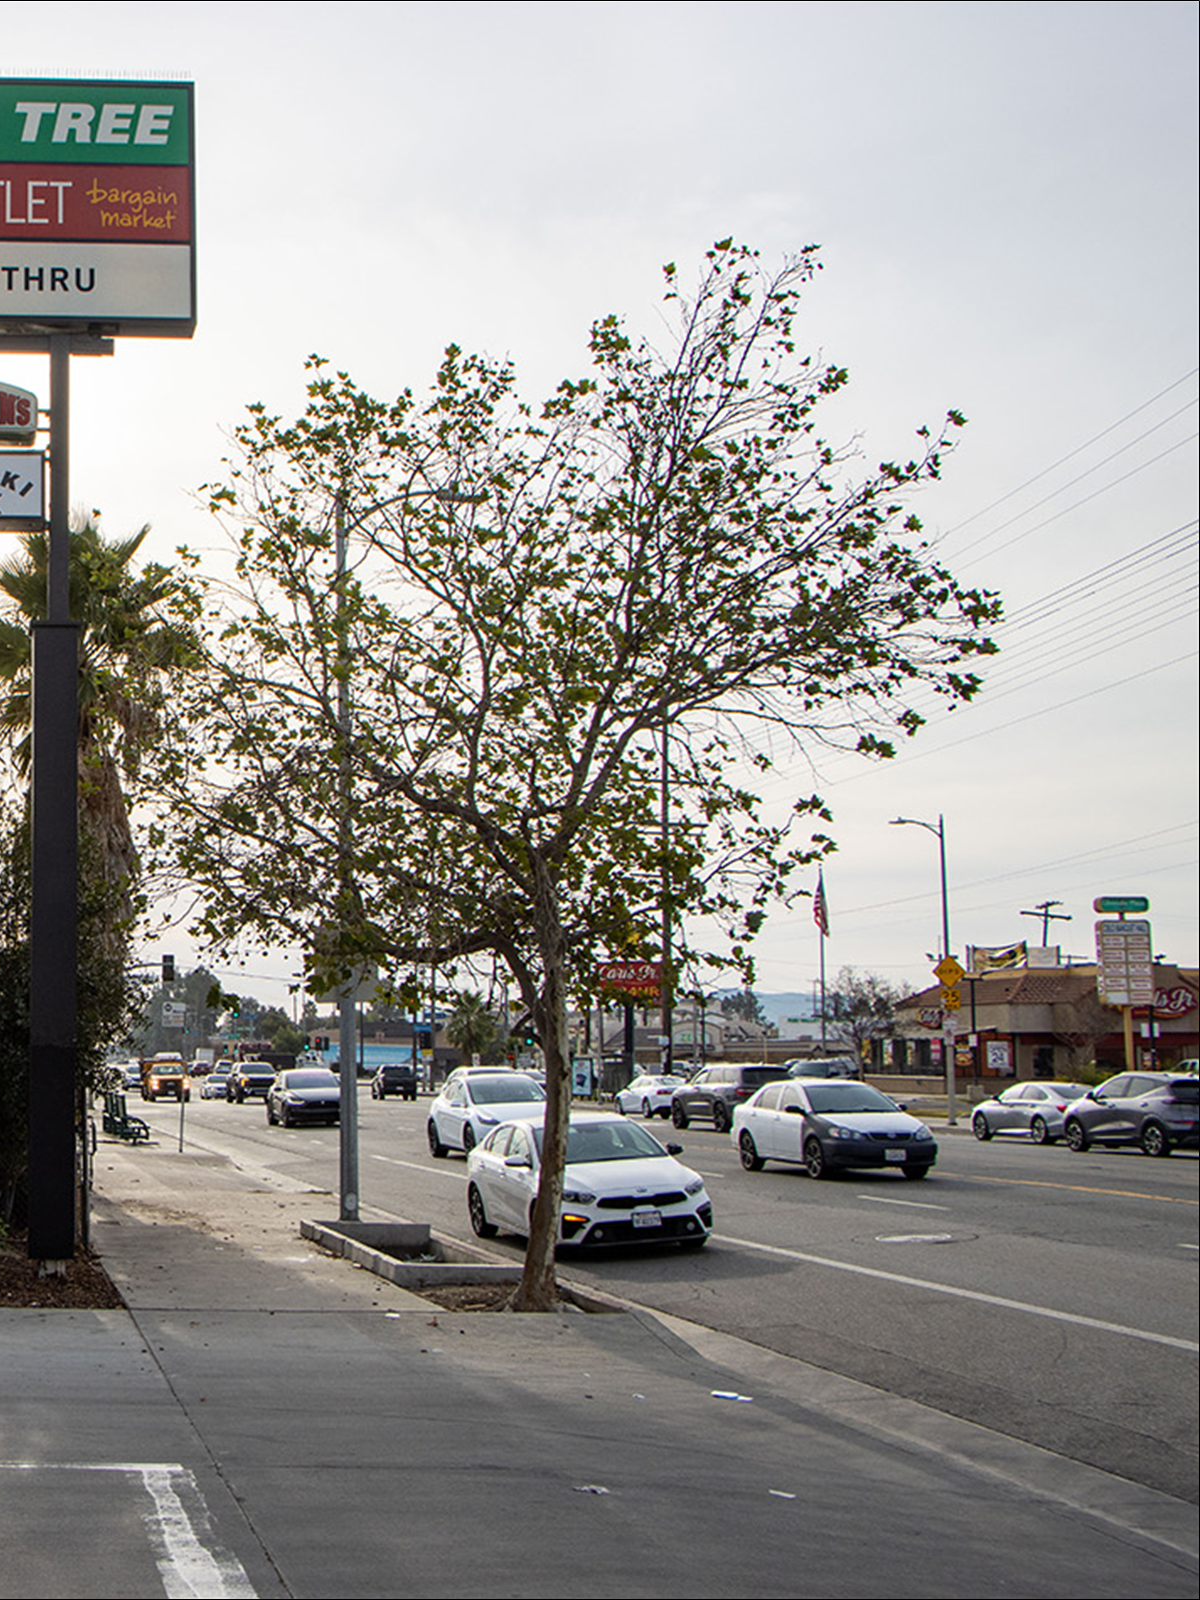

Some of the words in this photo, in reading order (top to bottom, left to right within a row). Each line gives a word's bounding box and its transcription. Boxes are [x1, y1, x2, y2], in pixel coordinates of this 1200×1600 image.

[15, 102, 174, 145] TREE
[85, 177, 178, 213] bargain
[100, 208, 177, 229] market
[1, 266, 96, 293] THRU
[941, 990, 959, 1003] 25
